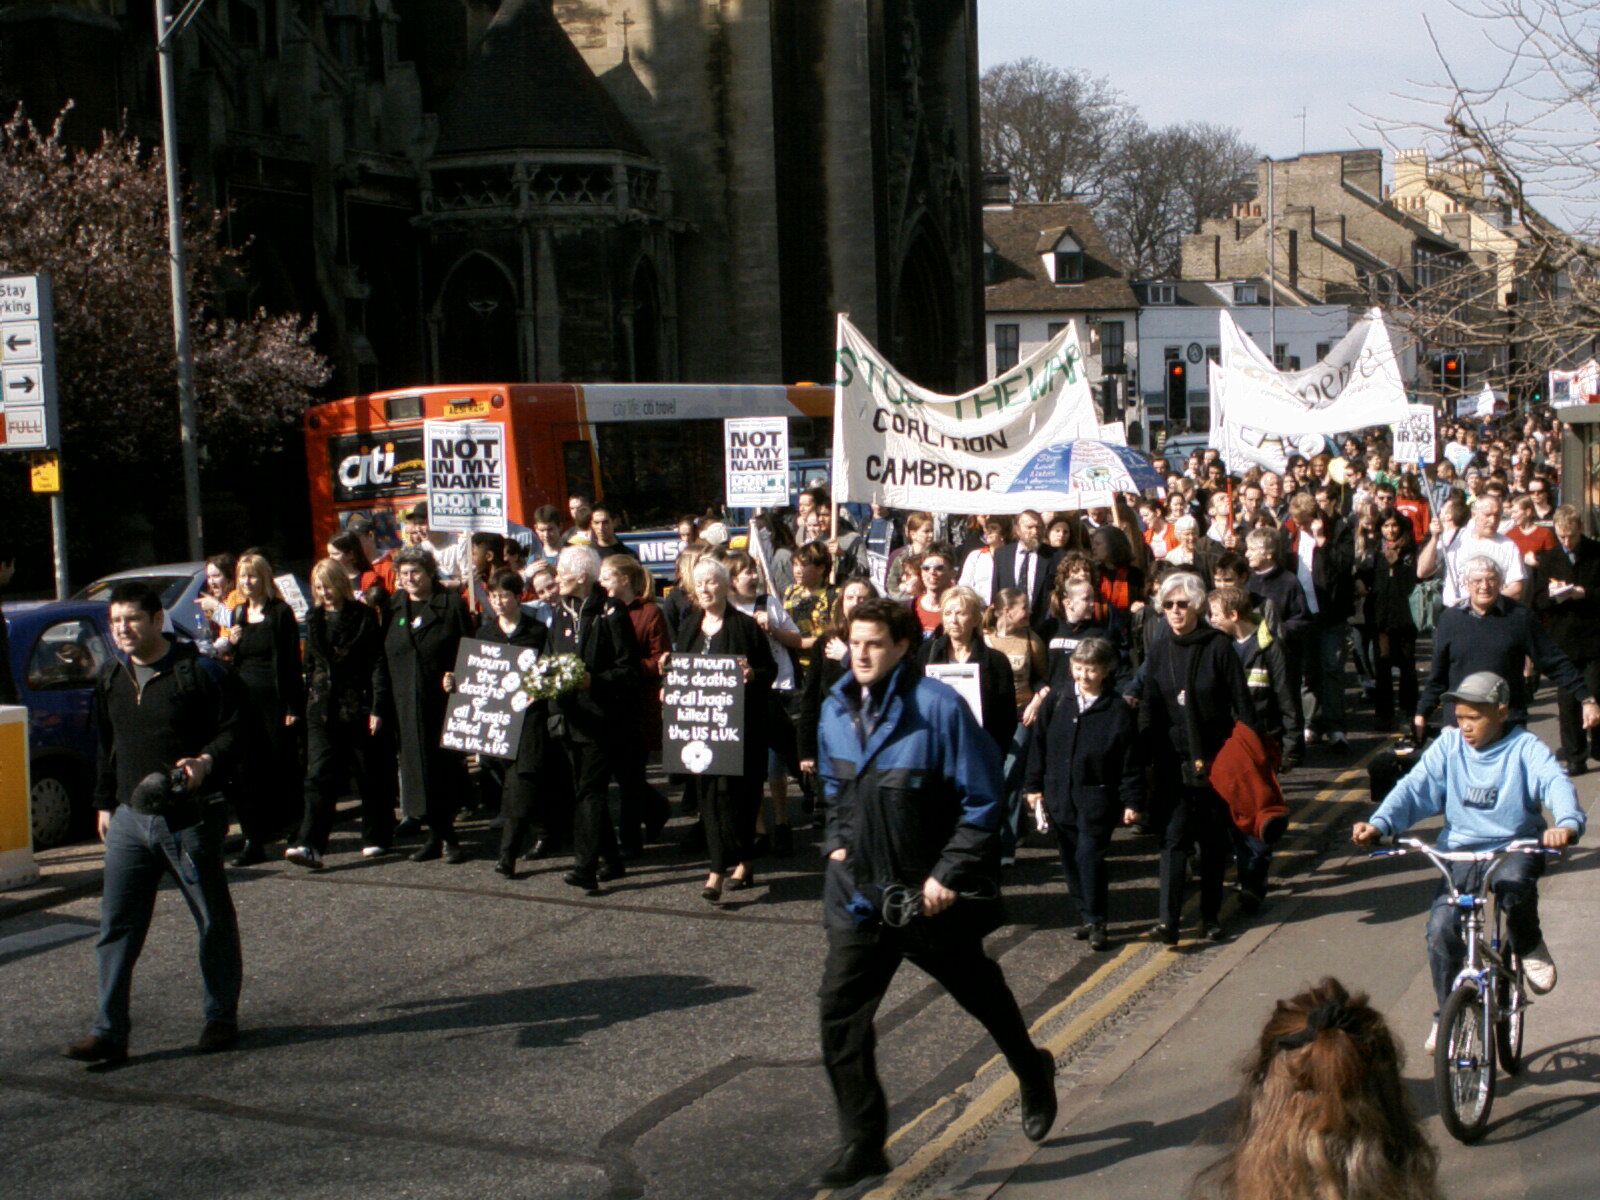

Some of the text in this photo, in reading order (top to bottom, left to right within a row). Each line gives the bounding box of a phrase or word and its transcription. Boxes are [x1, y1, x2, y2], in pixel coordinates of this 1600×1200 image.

[0, 285, 26, 298] Stay
[836, 346, 924, 408] STOP
[1027, 344, 1086, 401] WAR
[8, 421, 41, 434] FULL
[872, 408, 1008, 454] COALITION
[731, 431, 782, 447] NOT
[432, 439, 498, 458] NOT
[731, 448, 782, 459] IN MY
[432, 460, 454, 473] IN
[462, 460, 498, 473] MY
[731, 459, 784, 471] NAME
[432, 474, 500, 488] NAME
[1079, 479, 1130, 491] BLIND
[434, 494, 500, 507] DON'T
[434, 507, 501, 516] ATTACK IRAQ
[467, 654, 511, 671] mourn
[693, 657, 736, 670] mourn
[476, 669, 498, 685] the
[667, 671, 738, 688] the deaths
[458, 676, 506, 700] deaths
[471, 697, 488, 709] of
[665, 690, 734, 711] of all Iraqis
[453, 705, 511, 728] all Iraqis
[677, 707, 728, 727] killed by
[447, 717, 506, 742] killed by
[668, 725, 740, 742] the US & UK
[443, 733, 510, 755] the UK & US
[1465, 786, 1498, 803] NIKE
